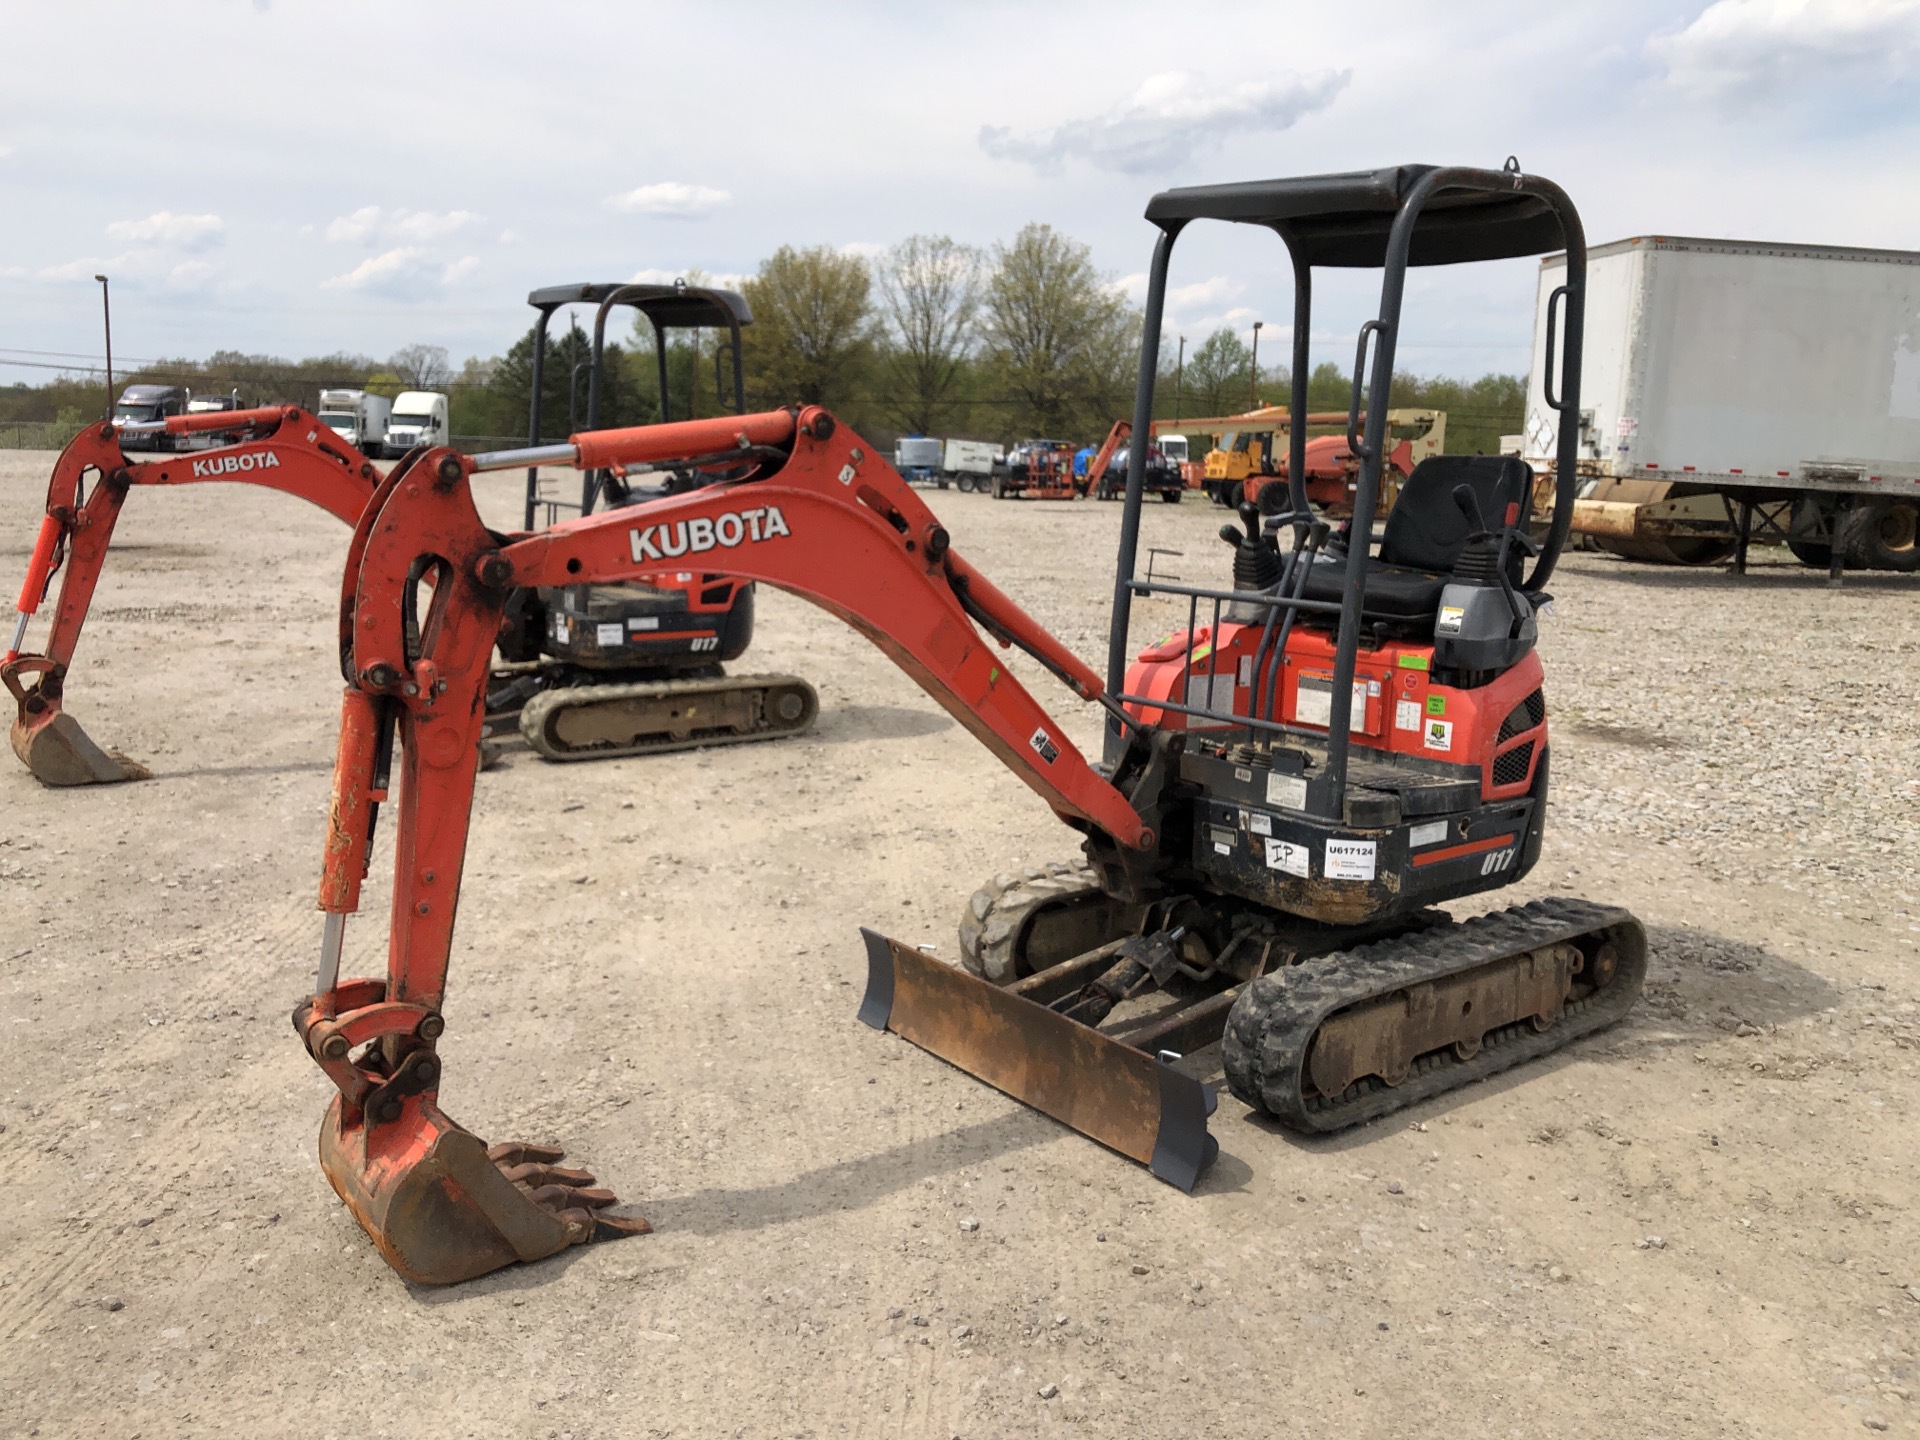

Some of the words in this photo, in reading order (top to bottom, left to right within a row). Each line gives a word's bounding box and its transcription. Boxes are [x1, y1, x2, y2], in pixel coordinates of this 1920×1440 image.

[192, 450, 280, 478] KUBOTA
[628, 505, 790, 563] KUBOTA
[690, 637, 719, 652] U17
[1329, 845, 1373, 856] U617124
[1480, 847, 1516, 876] U17
